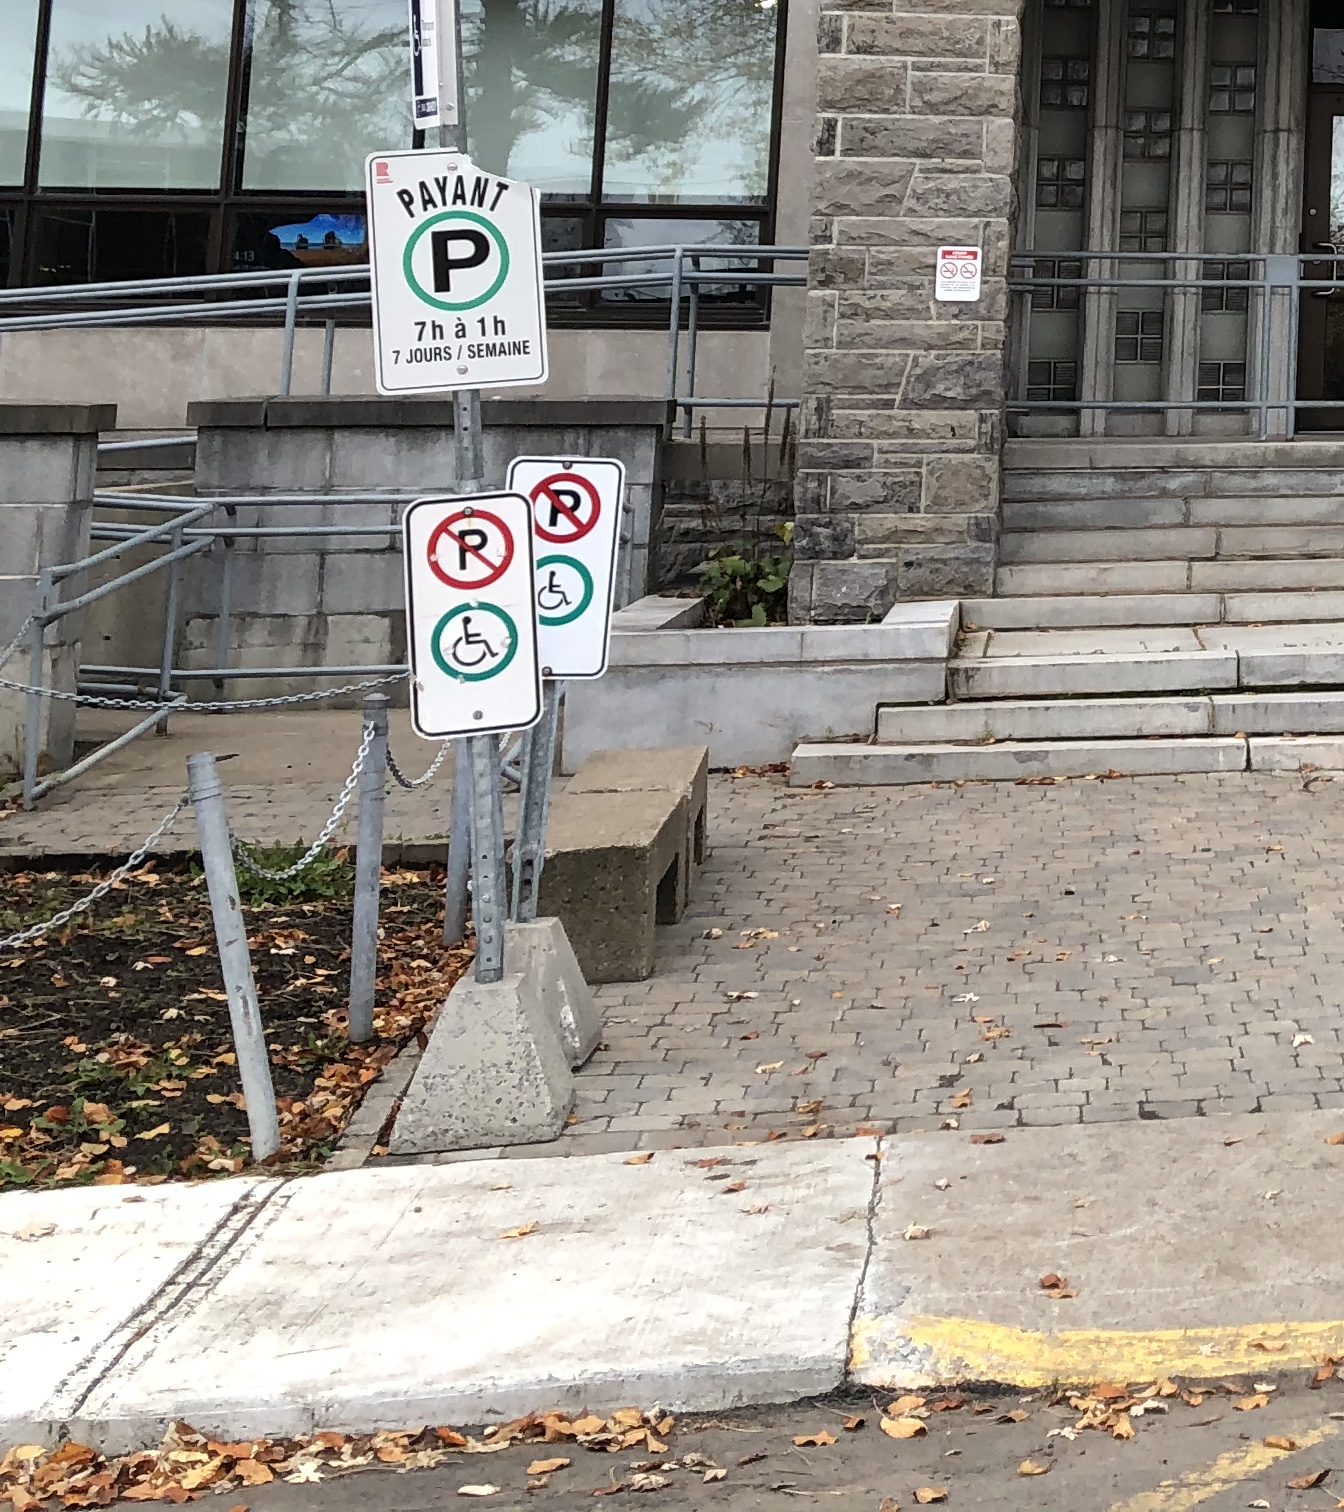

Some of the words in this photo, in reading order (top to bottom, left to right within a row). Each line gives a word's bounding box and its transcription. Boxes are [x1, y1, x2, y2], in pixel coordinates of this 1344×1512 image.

[396, 174, 509, 218] PAYANT
[431, 230, 490, 292] P
[414, 317, 444, 342] 7h
[454, 316, 467, 339] à
[476, 315, 506, 336] 1h
[392, 350, 400, 365] 7
[405, 346, 453, 364] JOURS
[456, 344, 463, 361] /
[467, 340, 531, 359] SEMAINE
